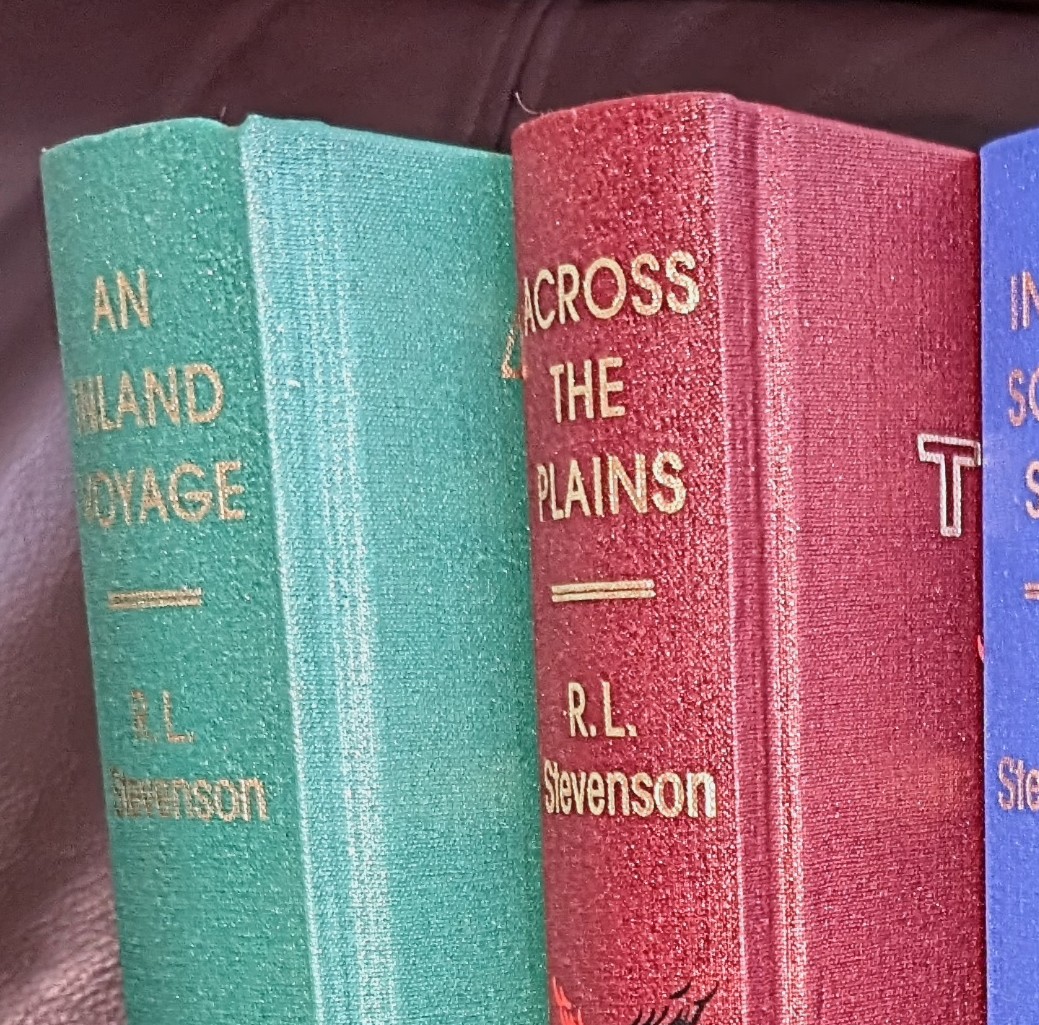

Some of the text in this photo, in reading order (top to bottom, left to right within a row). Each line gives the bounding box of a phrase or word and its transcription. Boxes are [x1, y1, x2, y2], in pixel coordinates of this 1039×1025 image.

[93, 267, 150, 332] AN
[523, 250, 700, 337] ACROSS
[549, 356, 626, 424] THE
[537, 450, 687, 522] PLAINS
[543, 759, 717, 819] Stevenson
